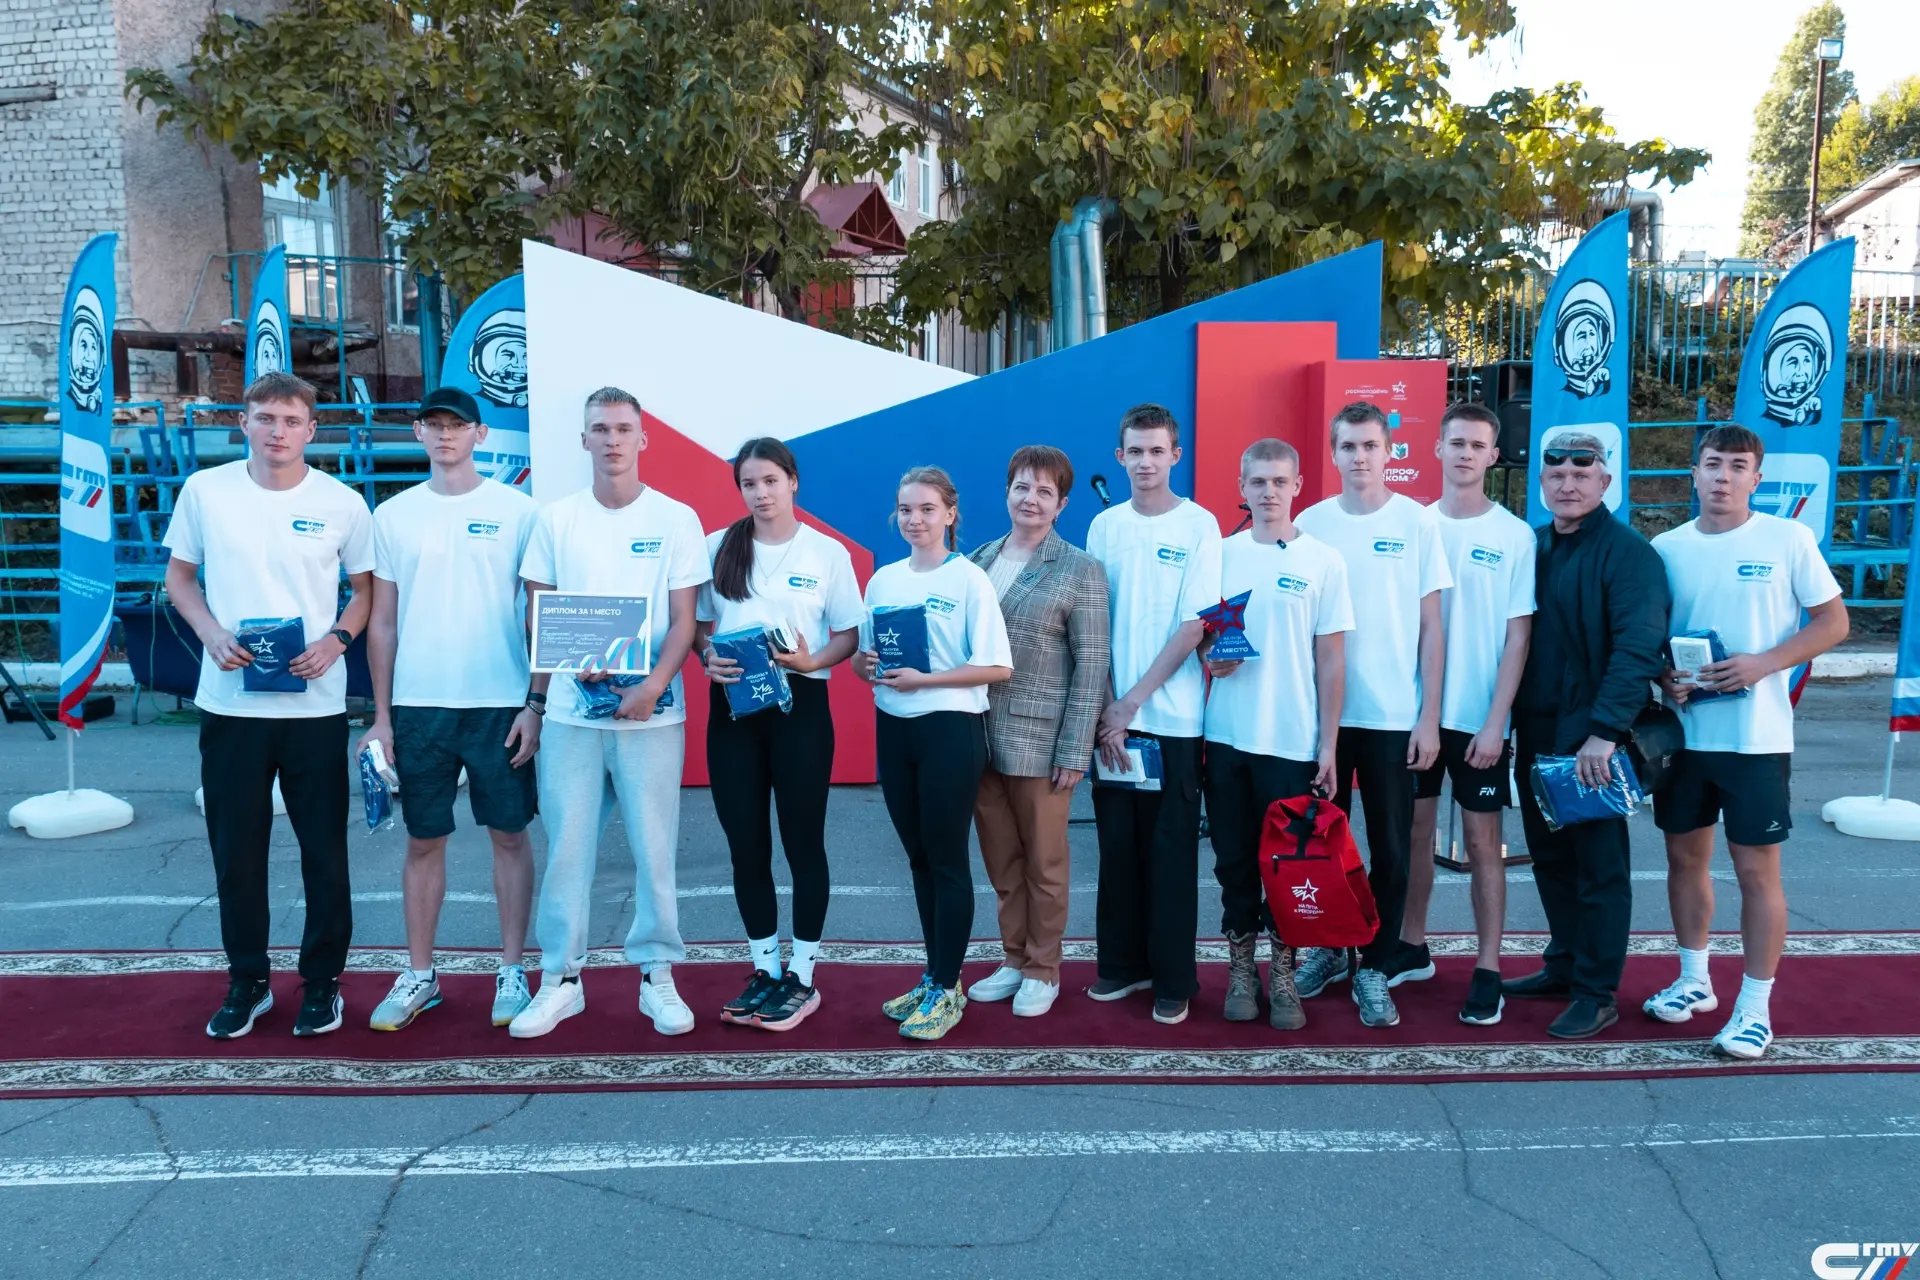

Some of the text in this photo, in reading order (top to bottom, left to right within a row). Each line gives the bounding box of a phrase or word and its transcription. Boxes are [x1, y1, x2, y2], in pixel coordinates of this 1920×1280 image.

[542, 607, 577, 615] ДИПЛОМ
[594, 608, 621, 616] МЕСТО
[1479, 787, 1496, 796] FN
